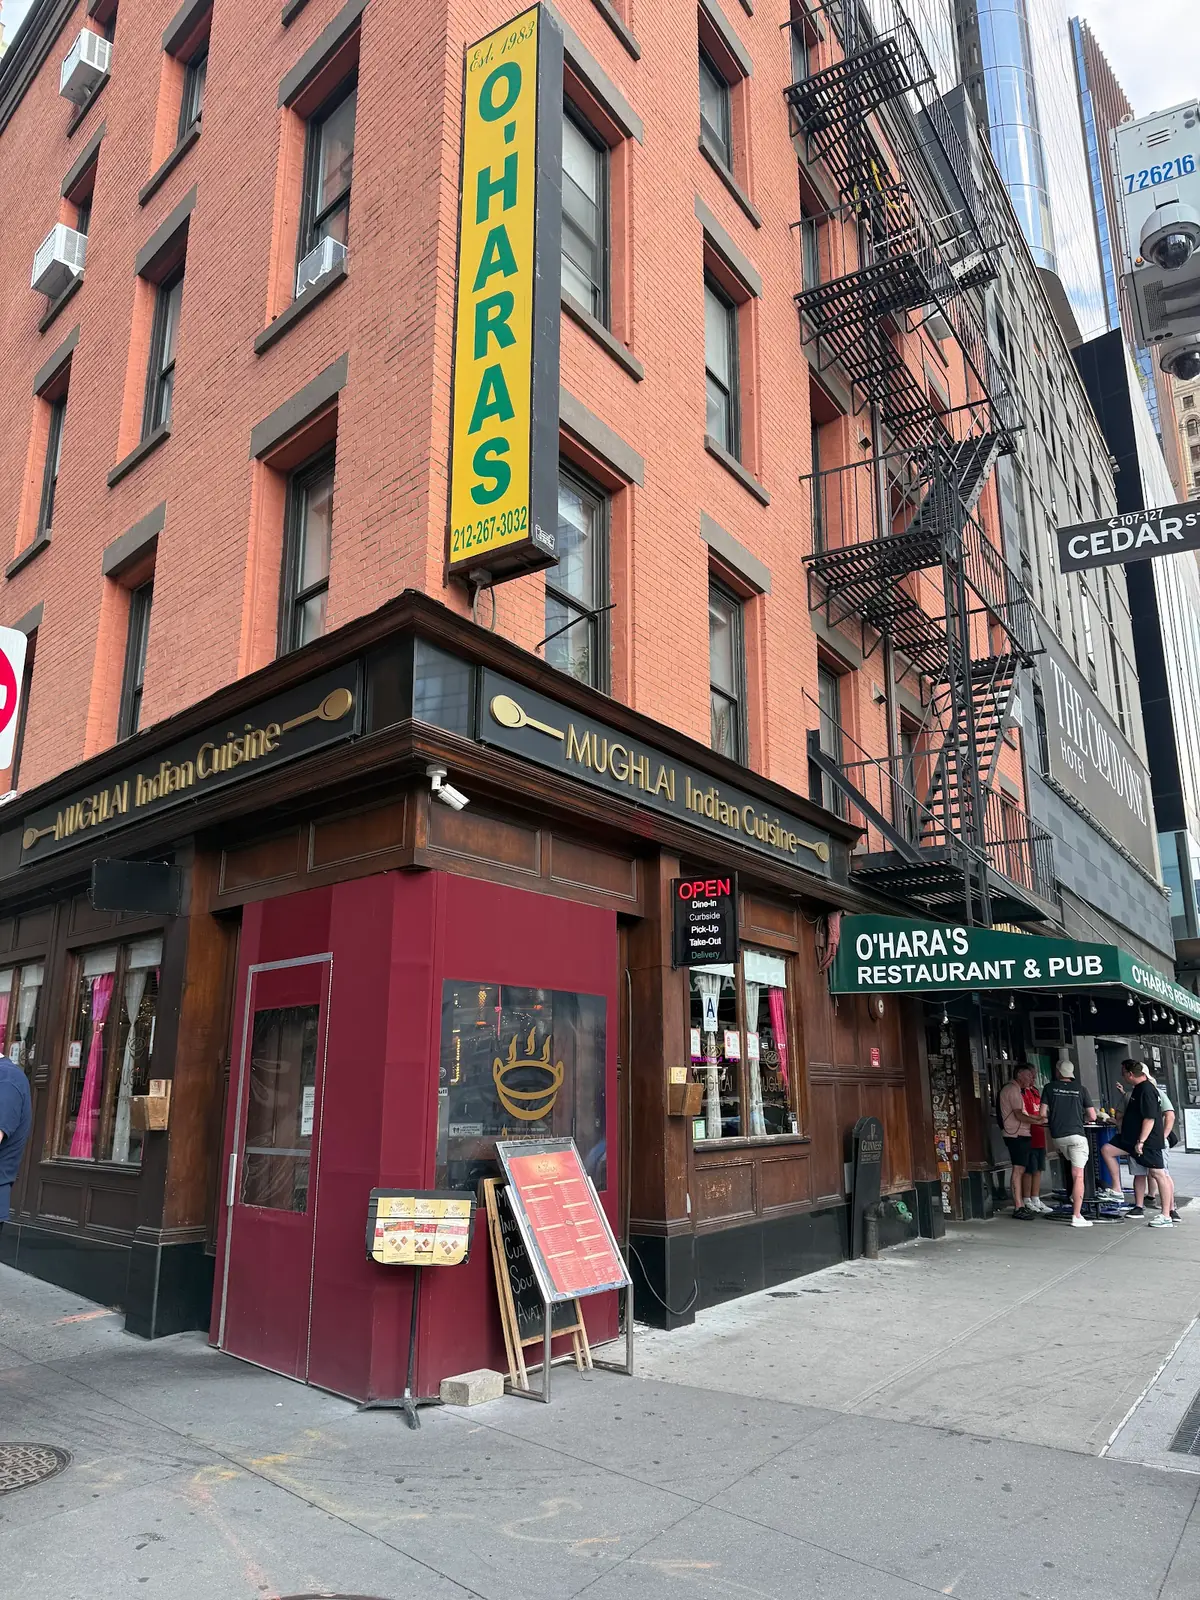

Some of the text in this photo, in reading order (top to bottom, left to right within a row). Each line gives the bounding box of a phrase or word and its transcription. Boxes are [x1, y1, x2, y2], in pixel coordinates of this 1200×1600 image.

[469, 20, 535, 72] Est. 1983
[452, 505, 528, 552] 212-267-3032
[1120, 509, 1164, 527] 107-127
[1067, 517, 1185, 559] CEDAR
[1049, 656, 1089, 757] THE
[1122, 756, 1148, 827] ONE
[1060, 737, 1087, 784] HOTEL
[54, 722, 284, 842] MUGHLAI Indian Cuisine
[565, 723, 798, 853] MUGHLAI Indian Cuisine
[678, 878, 731, 900] OPEN
[691, 899, 717, 909] Dine-In
[689, 912, 721, 921] Curbside
[691, 925, 719, 934] Pick-Up
[689, 937, 722, 947] Take-Out
[691, 951, 720, 960] Delivery
[855, 927, 969, 961] O'HARA'S
[857, 955, 1104, 985] RESTAURANT & PUB
[1131, 964, 1175, 1000] O'HARA'S
[706, 997, 715, 1018] A
